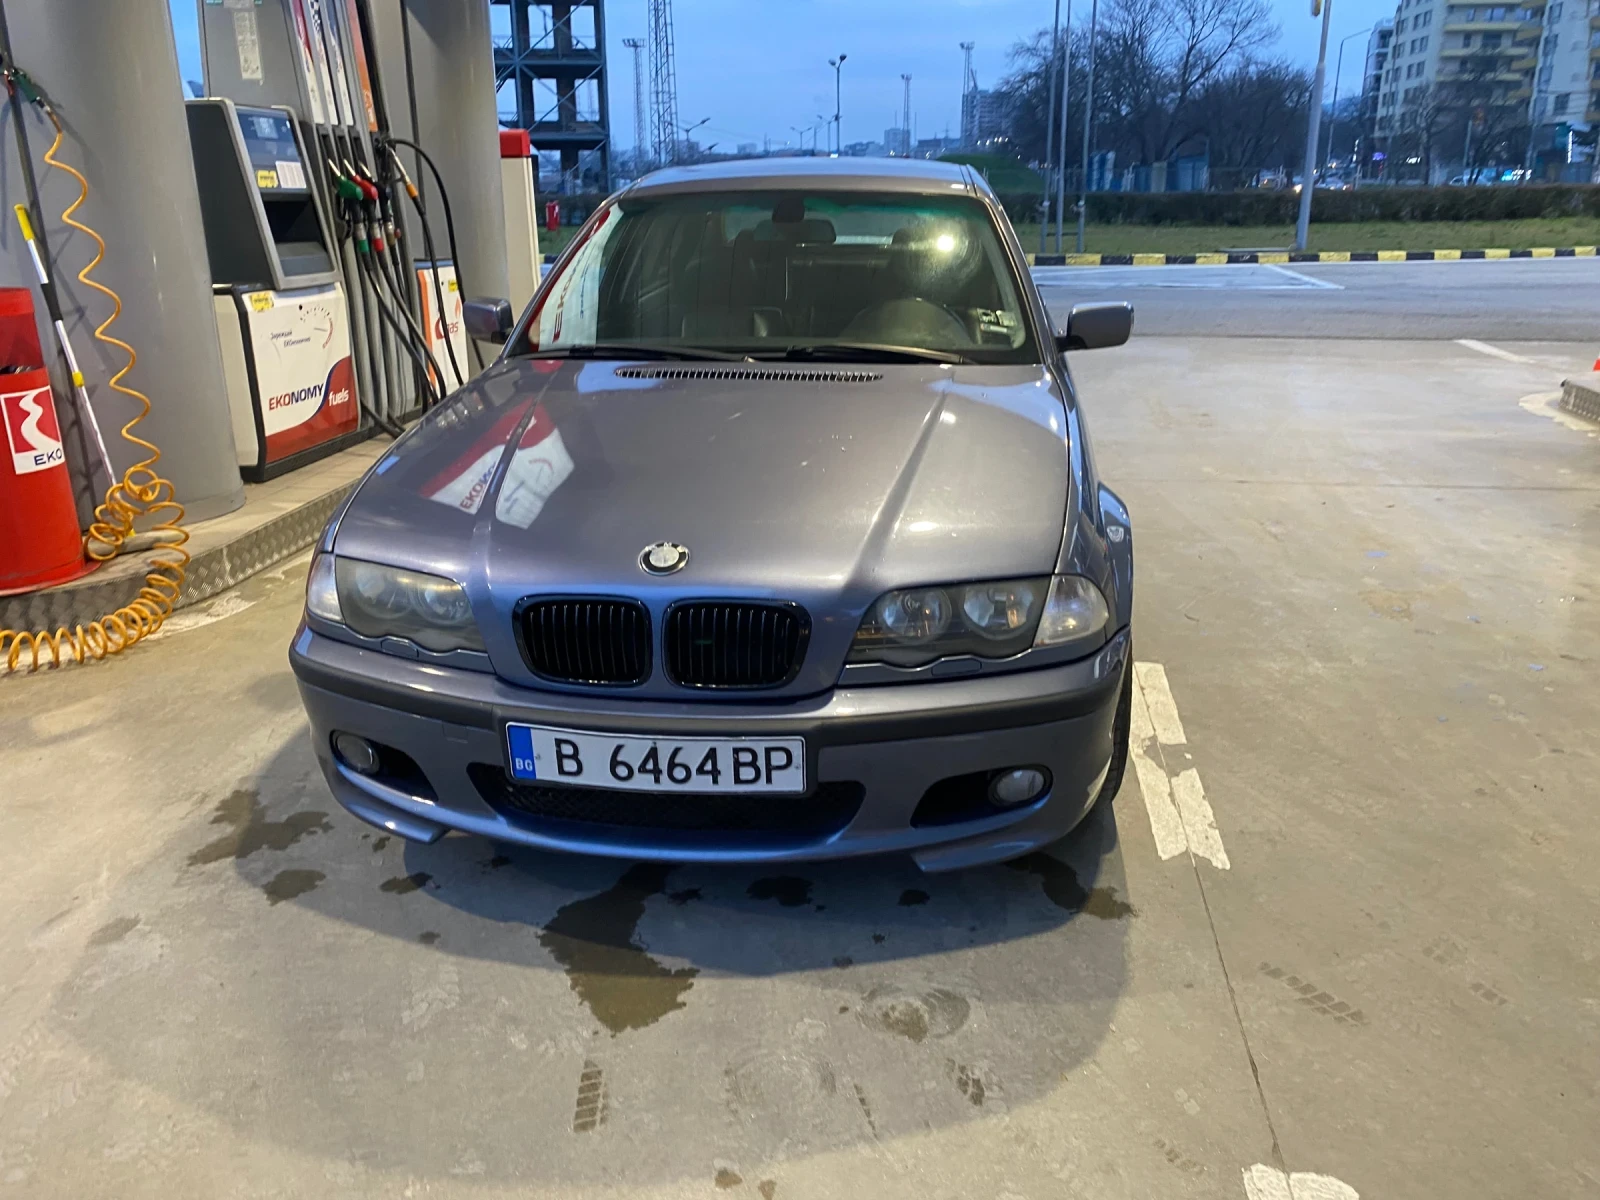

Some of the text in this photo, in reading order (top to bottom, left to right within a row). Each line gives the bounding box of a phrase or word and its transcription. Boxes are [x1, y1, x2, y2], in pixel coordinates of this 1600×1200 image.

[268, 383, 349, 411] EKONOMY fuels
[33, 447, 63, 466] EKO
[514, 757, 534, 772] BG
[554, 737, 584, 776] B
